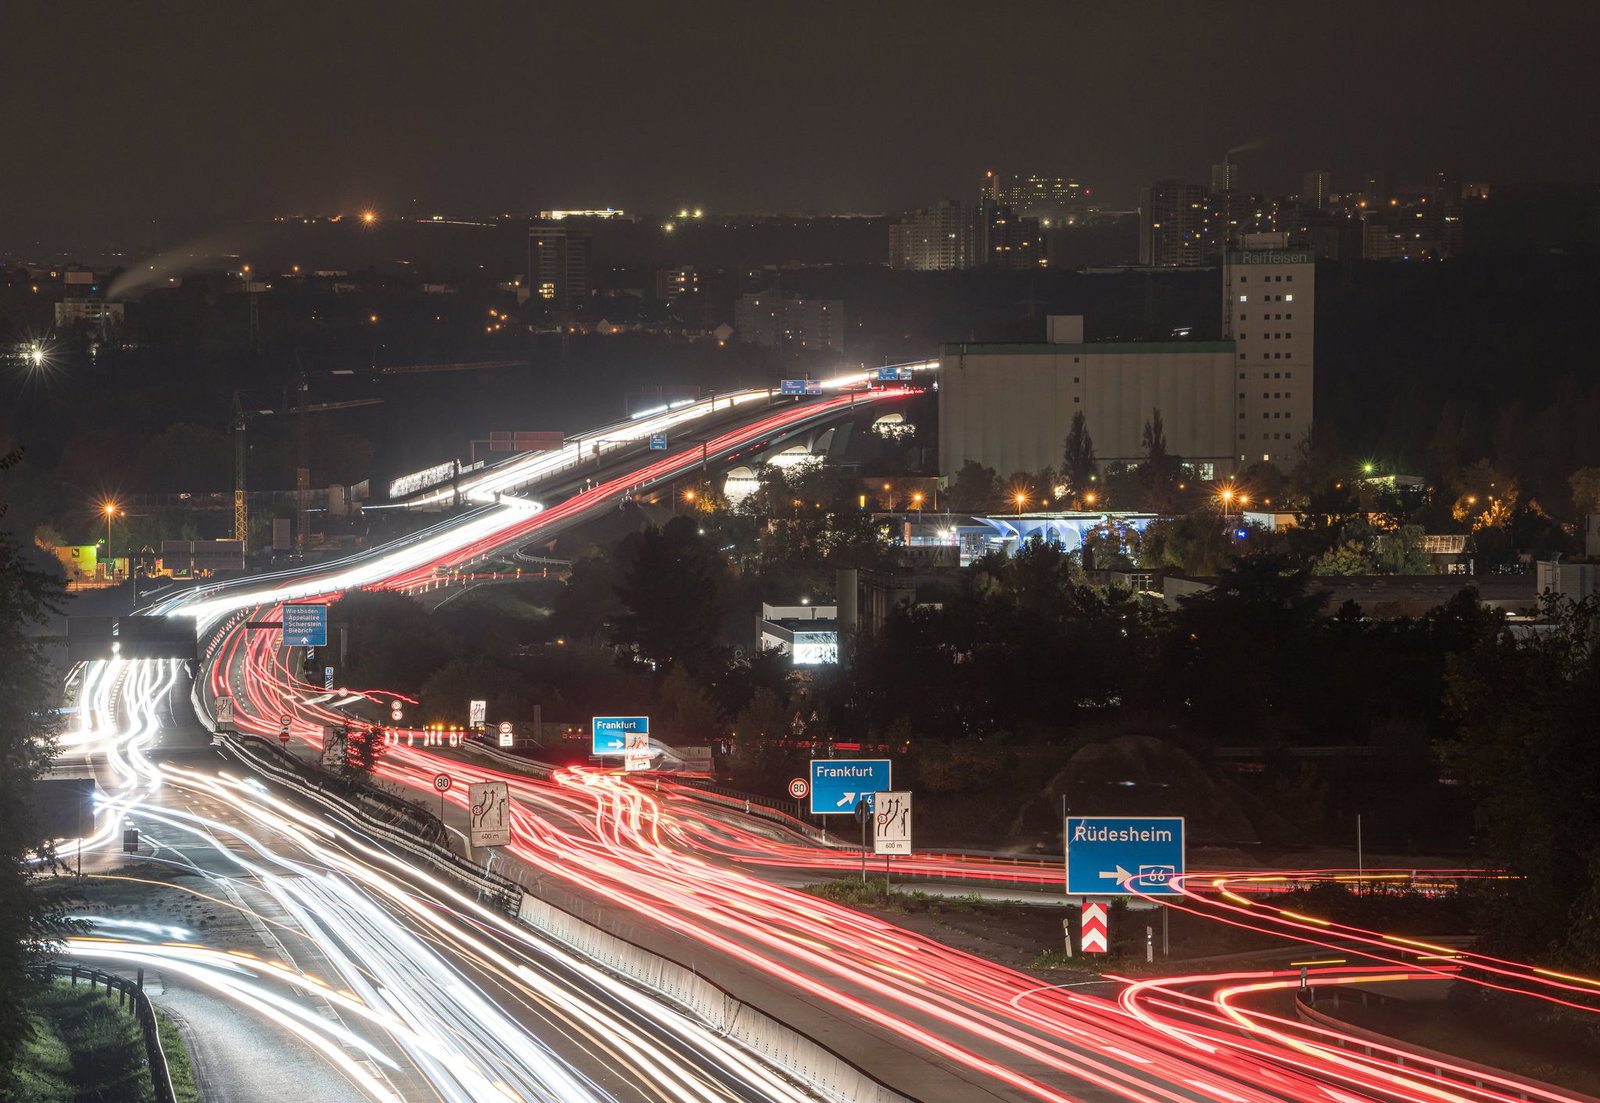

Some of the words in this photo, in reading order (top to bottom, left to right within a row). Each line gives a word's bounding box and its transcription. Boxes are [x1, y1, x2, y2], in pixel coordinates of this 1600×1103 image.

[1242, 250, 1307, 264] Raiffeisen
[597, 721, 636, 729] Frankfurt
[816, 766, 873, 777] Frankfurt
[437, 778, 449, 787] 80
[793, 783, 805, 793] 80
[1075, 826, 1172, 842] Rüdesheim
[1149, 869, 1165, 882] 66
